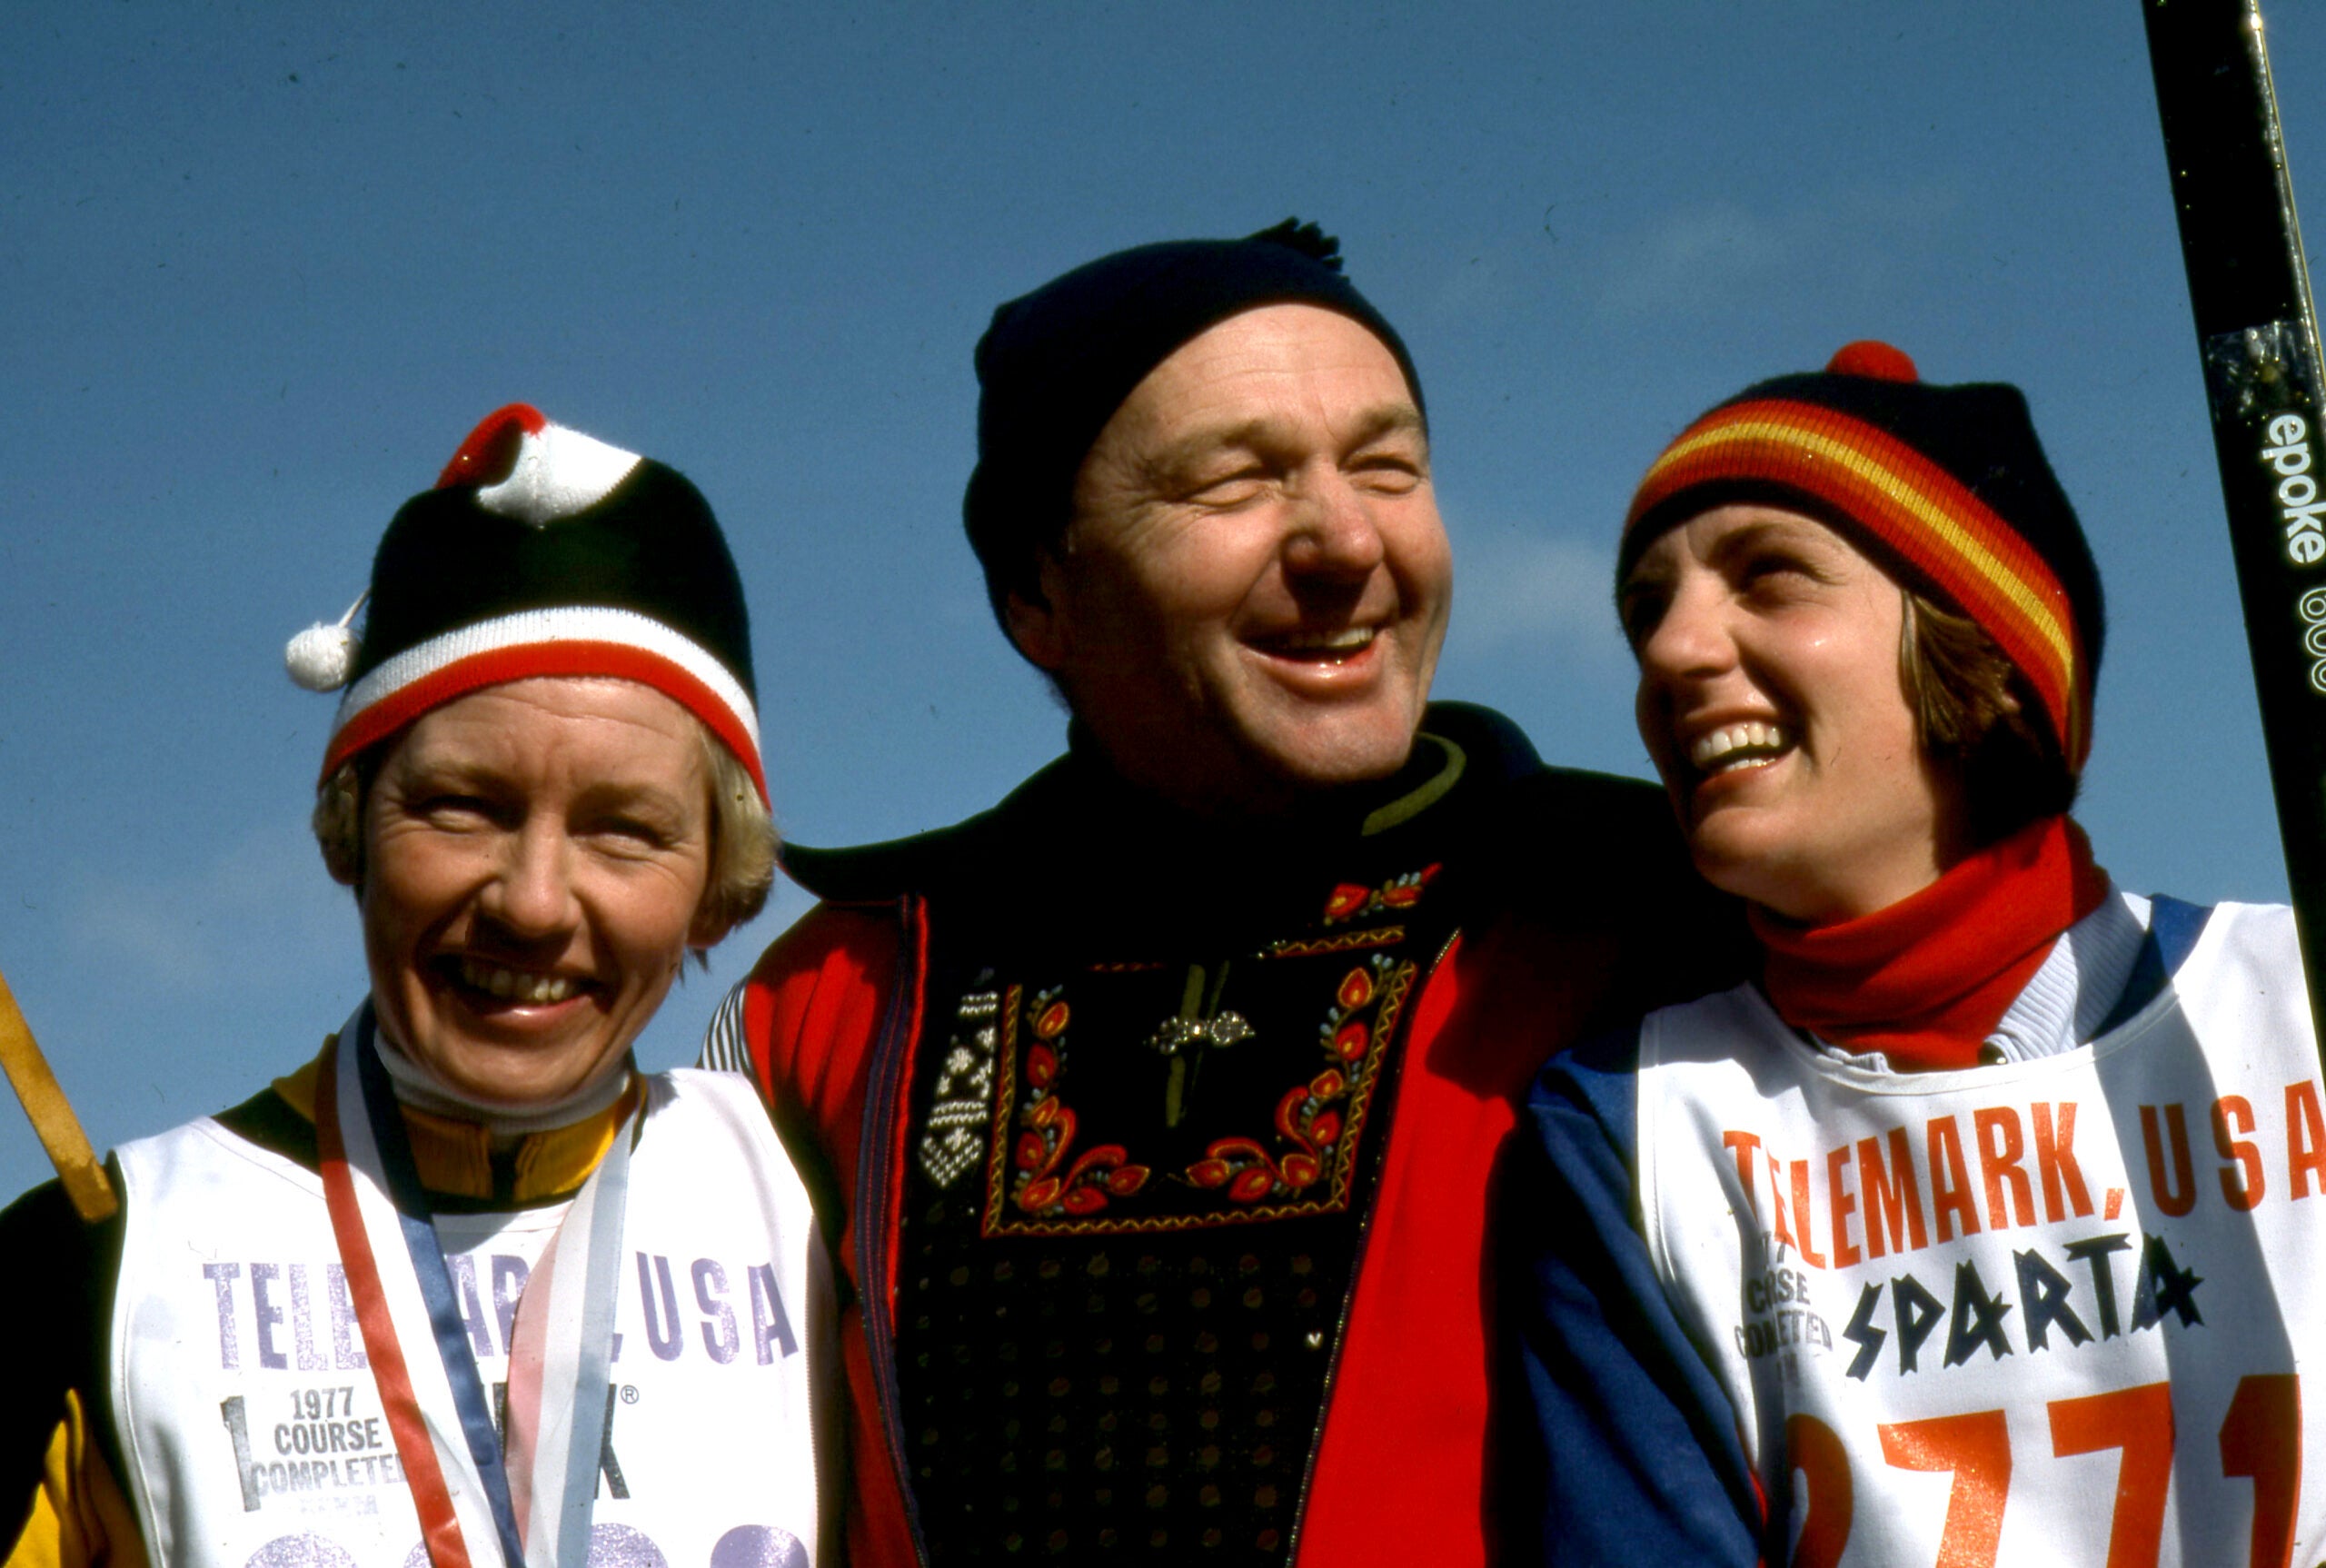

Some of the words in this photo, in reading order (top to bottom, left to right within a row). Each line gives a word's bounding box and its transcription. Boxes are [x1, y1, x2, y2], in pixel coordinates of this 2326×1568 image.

[2262, 413, 2326, 564] epoke
[1723, 1101, 2125, 1270] TELEMARK,
[2138, 1079, 2326, 1217] USA
[636, 1251, 799, 1366] USA
[1842, 1233, 2204, 1382] SPARTA
[274, 1417, 383, 1455] COURSE
[290, 1386, 353, 1421] 1977
